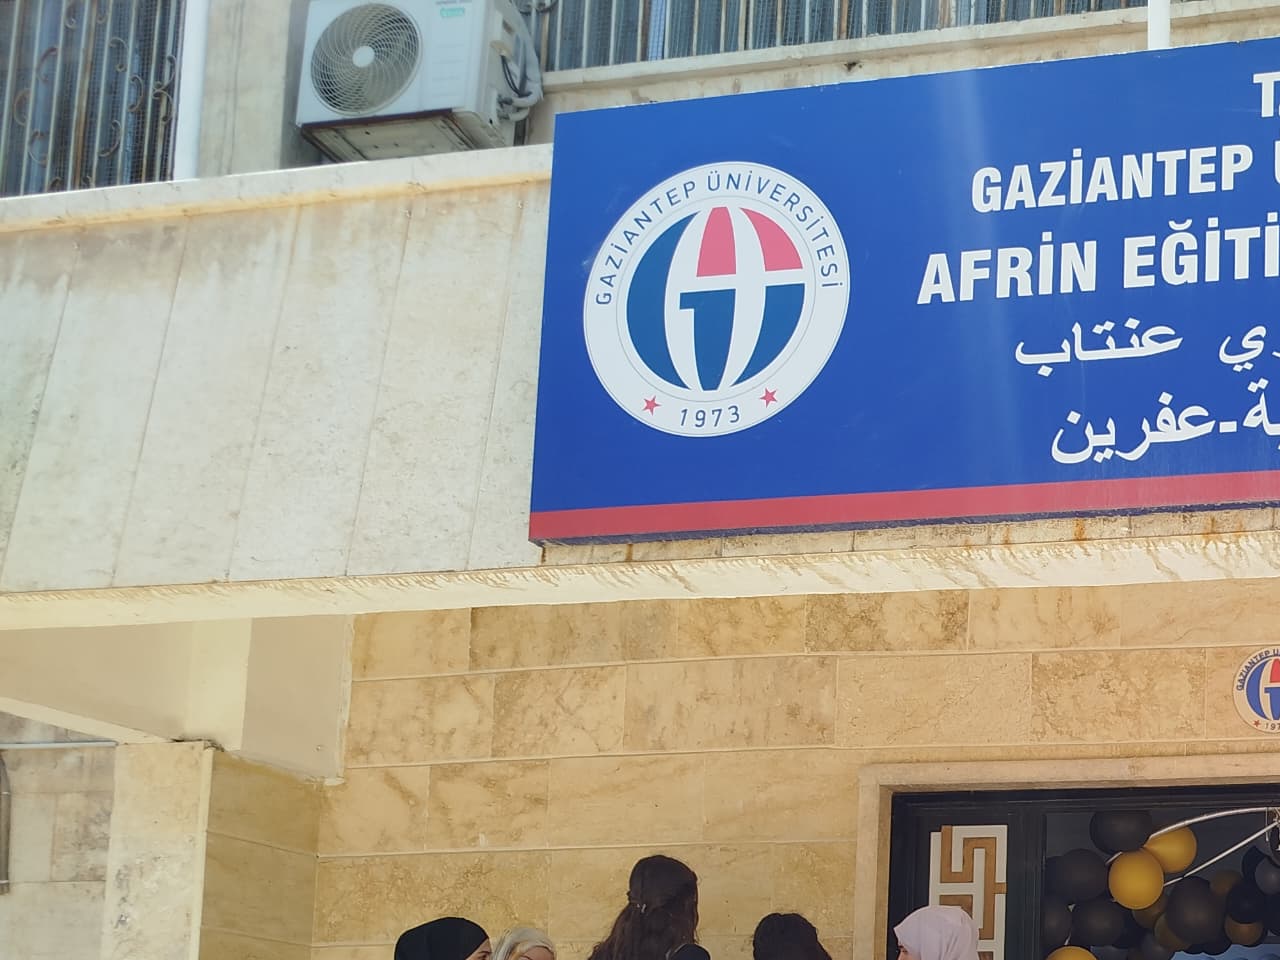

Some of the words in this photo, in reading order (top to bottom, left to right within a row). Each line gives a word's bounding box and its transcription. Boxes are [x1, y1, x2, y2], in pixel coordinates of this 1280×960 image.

[971, 147, 1254, 213] GAZİANTEP
[595, 180, 697, 306] GAZİANTEP
[706, 170, 844, 288] ÜNİVERSİTESİ
[916, 231, 1097, 305] AFRİN
[1014, 317, 1184, 377] عنتاب
[680, 404, 741, 429] 1973
